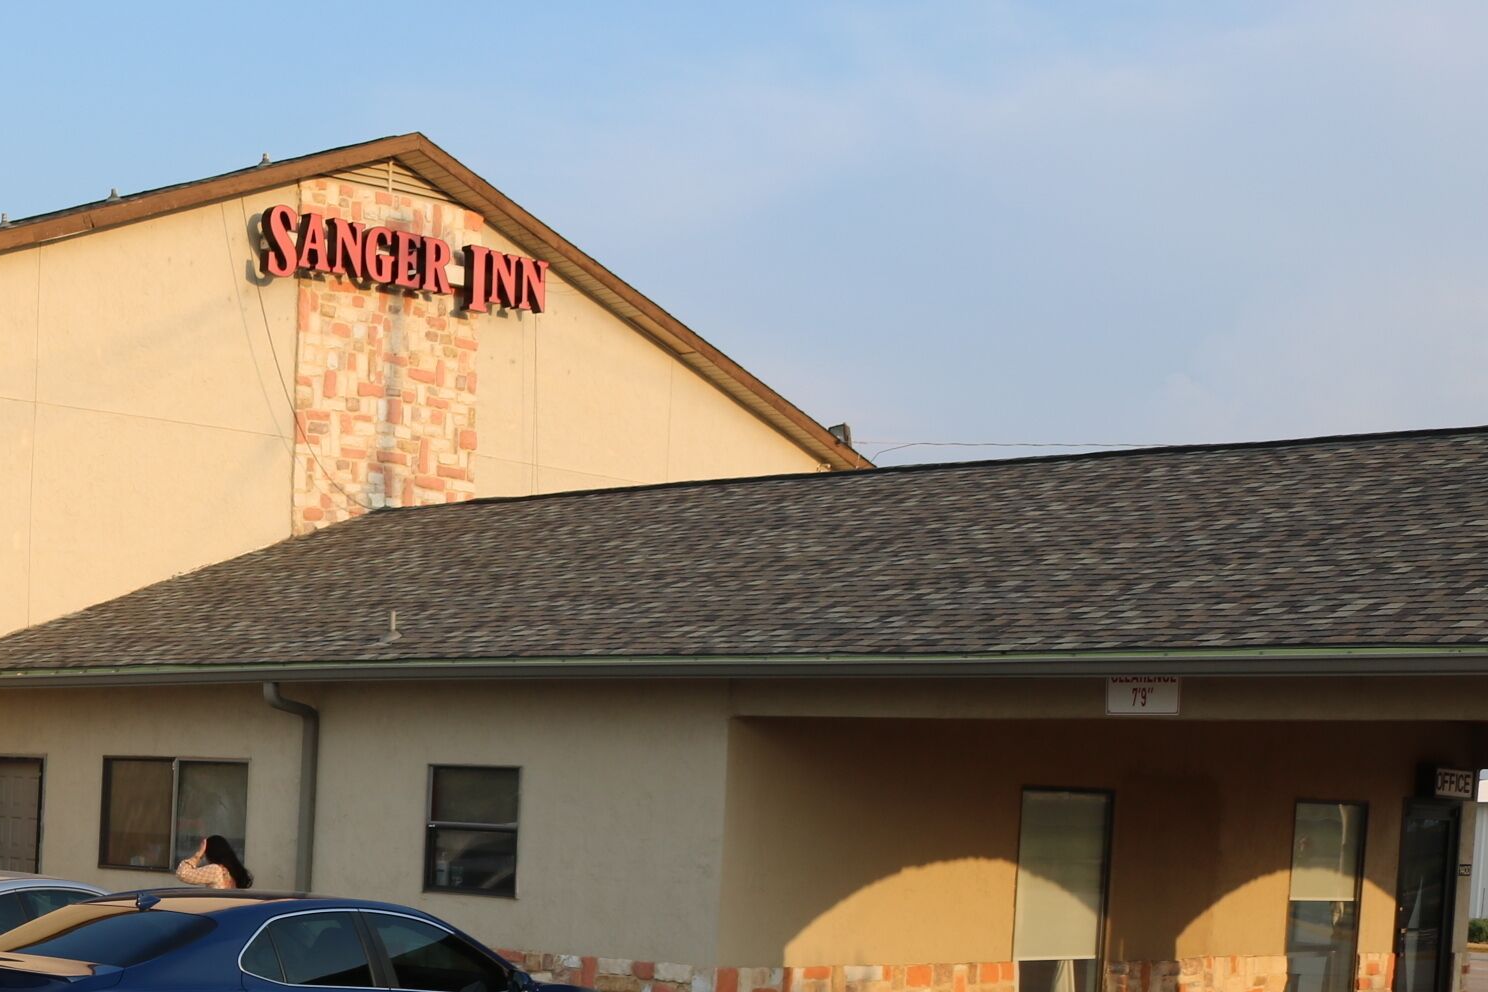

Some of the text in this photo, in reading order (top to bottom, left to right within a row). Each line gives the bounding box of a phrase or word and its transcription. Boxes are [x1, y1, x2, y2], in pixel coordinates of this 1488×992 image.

[263, 204, 550, 314] SANGER INN
[1435, 771, 1472, 794] OFFICE
